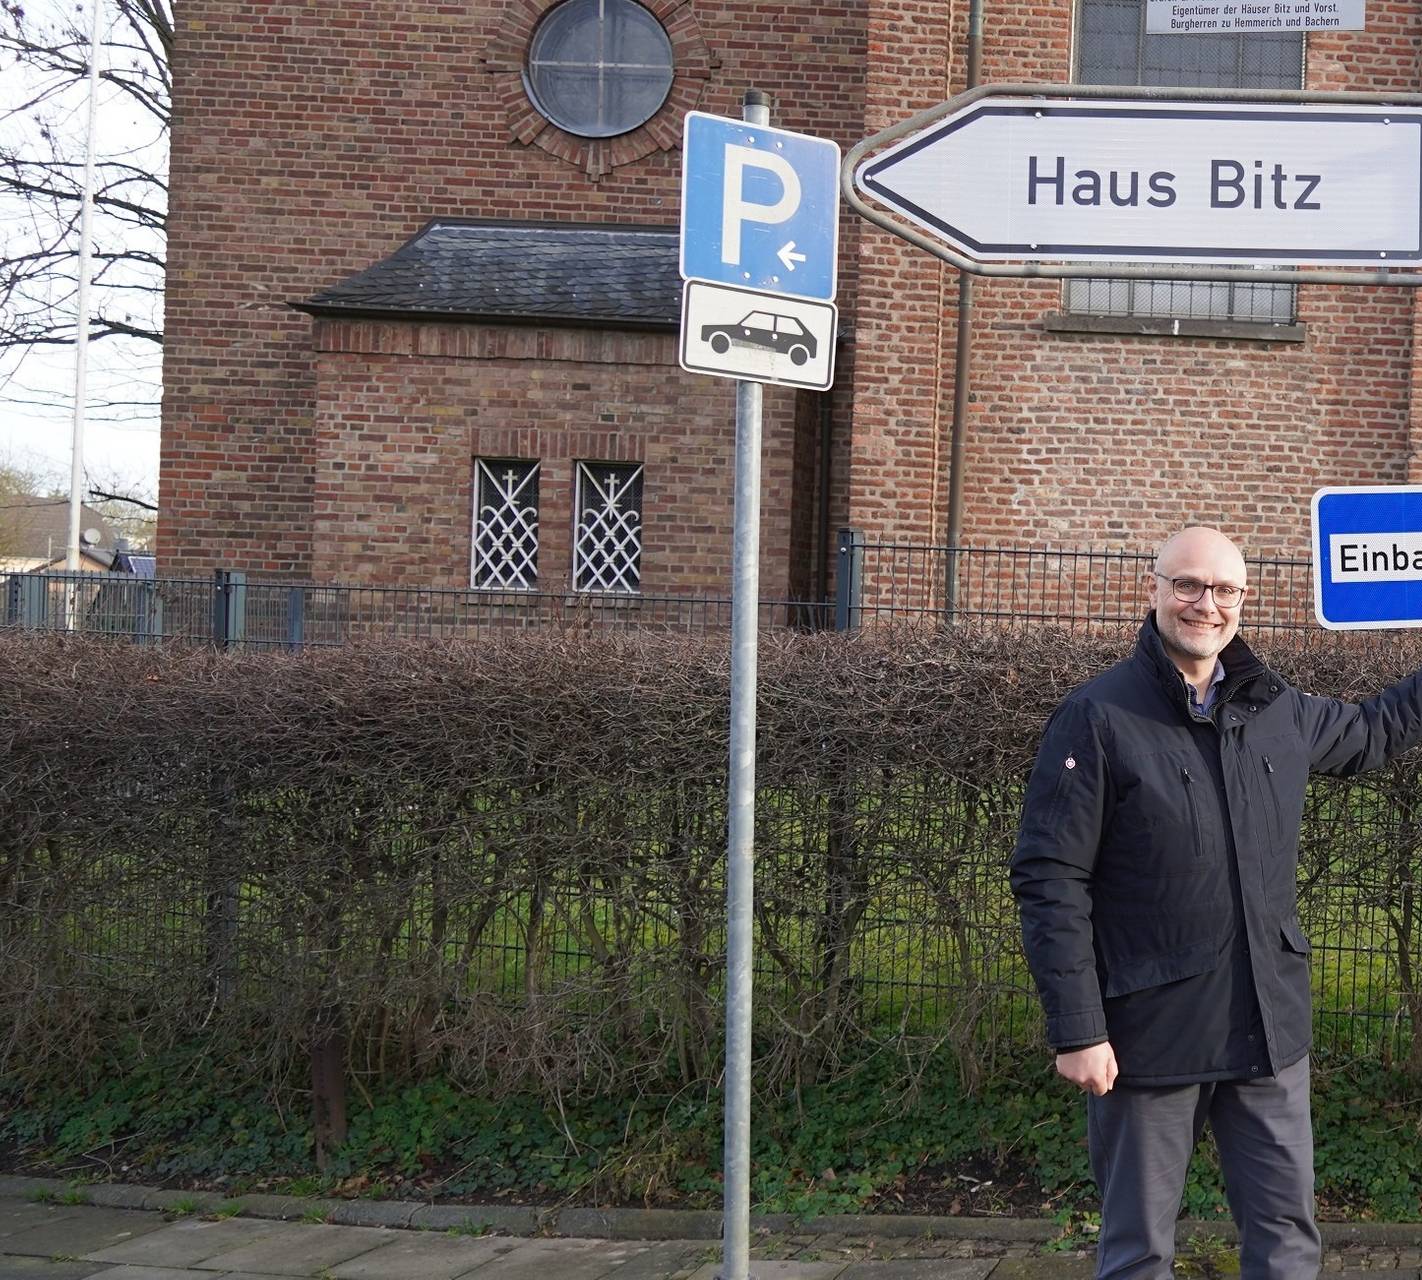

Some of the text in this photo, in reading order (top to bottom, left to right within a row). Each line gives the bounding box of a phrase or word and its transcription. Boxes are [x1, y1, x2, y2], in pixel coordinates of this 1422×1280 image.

[1171, 16, 1340, 31] Burgherren zu Hemmerich und Bachern
[1172, 2, 1339, 18] Eigentümer der Häuser Bitz und Vorst.
[1027, 156, 1322, 211] Haus Bitz
[721, 143, 802, 266] P
